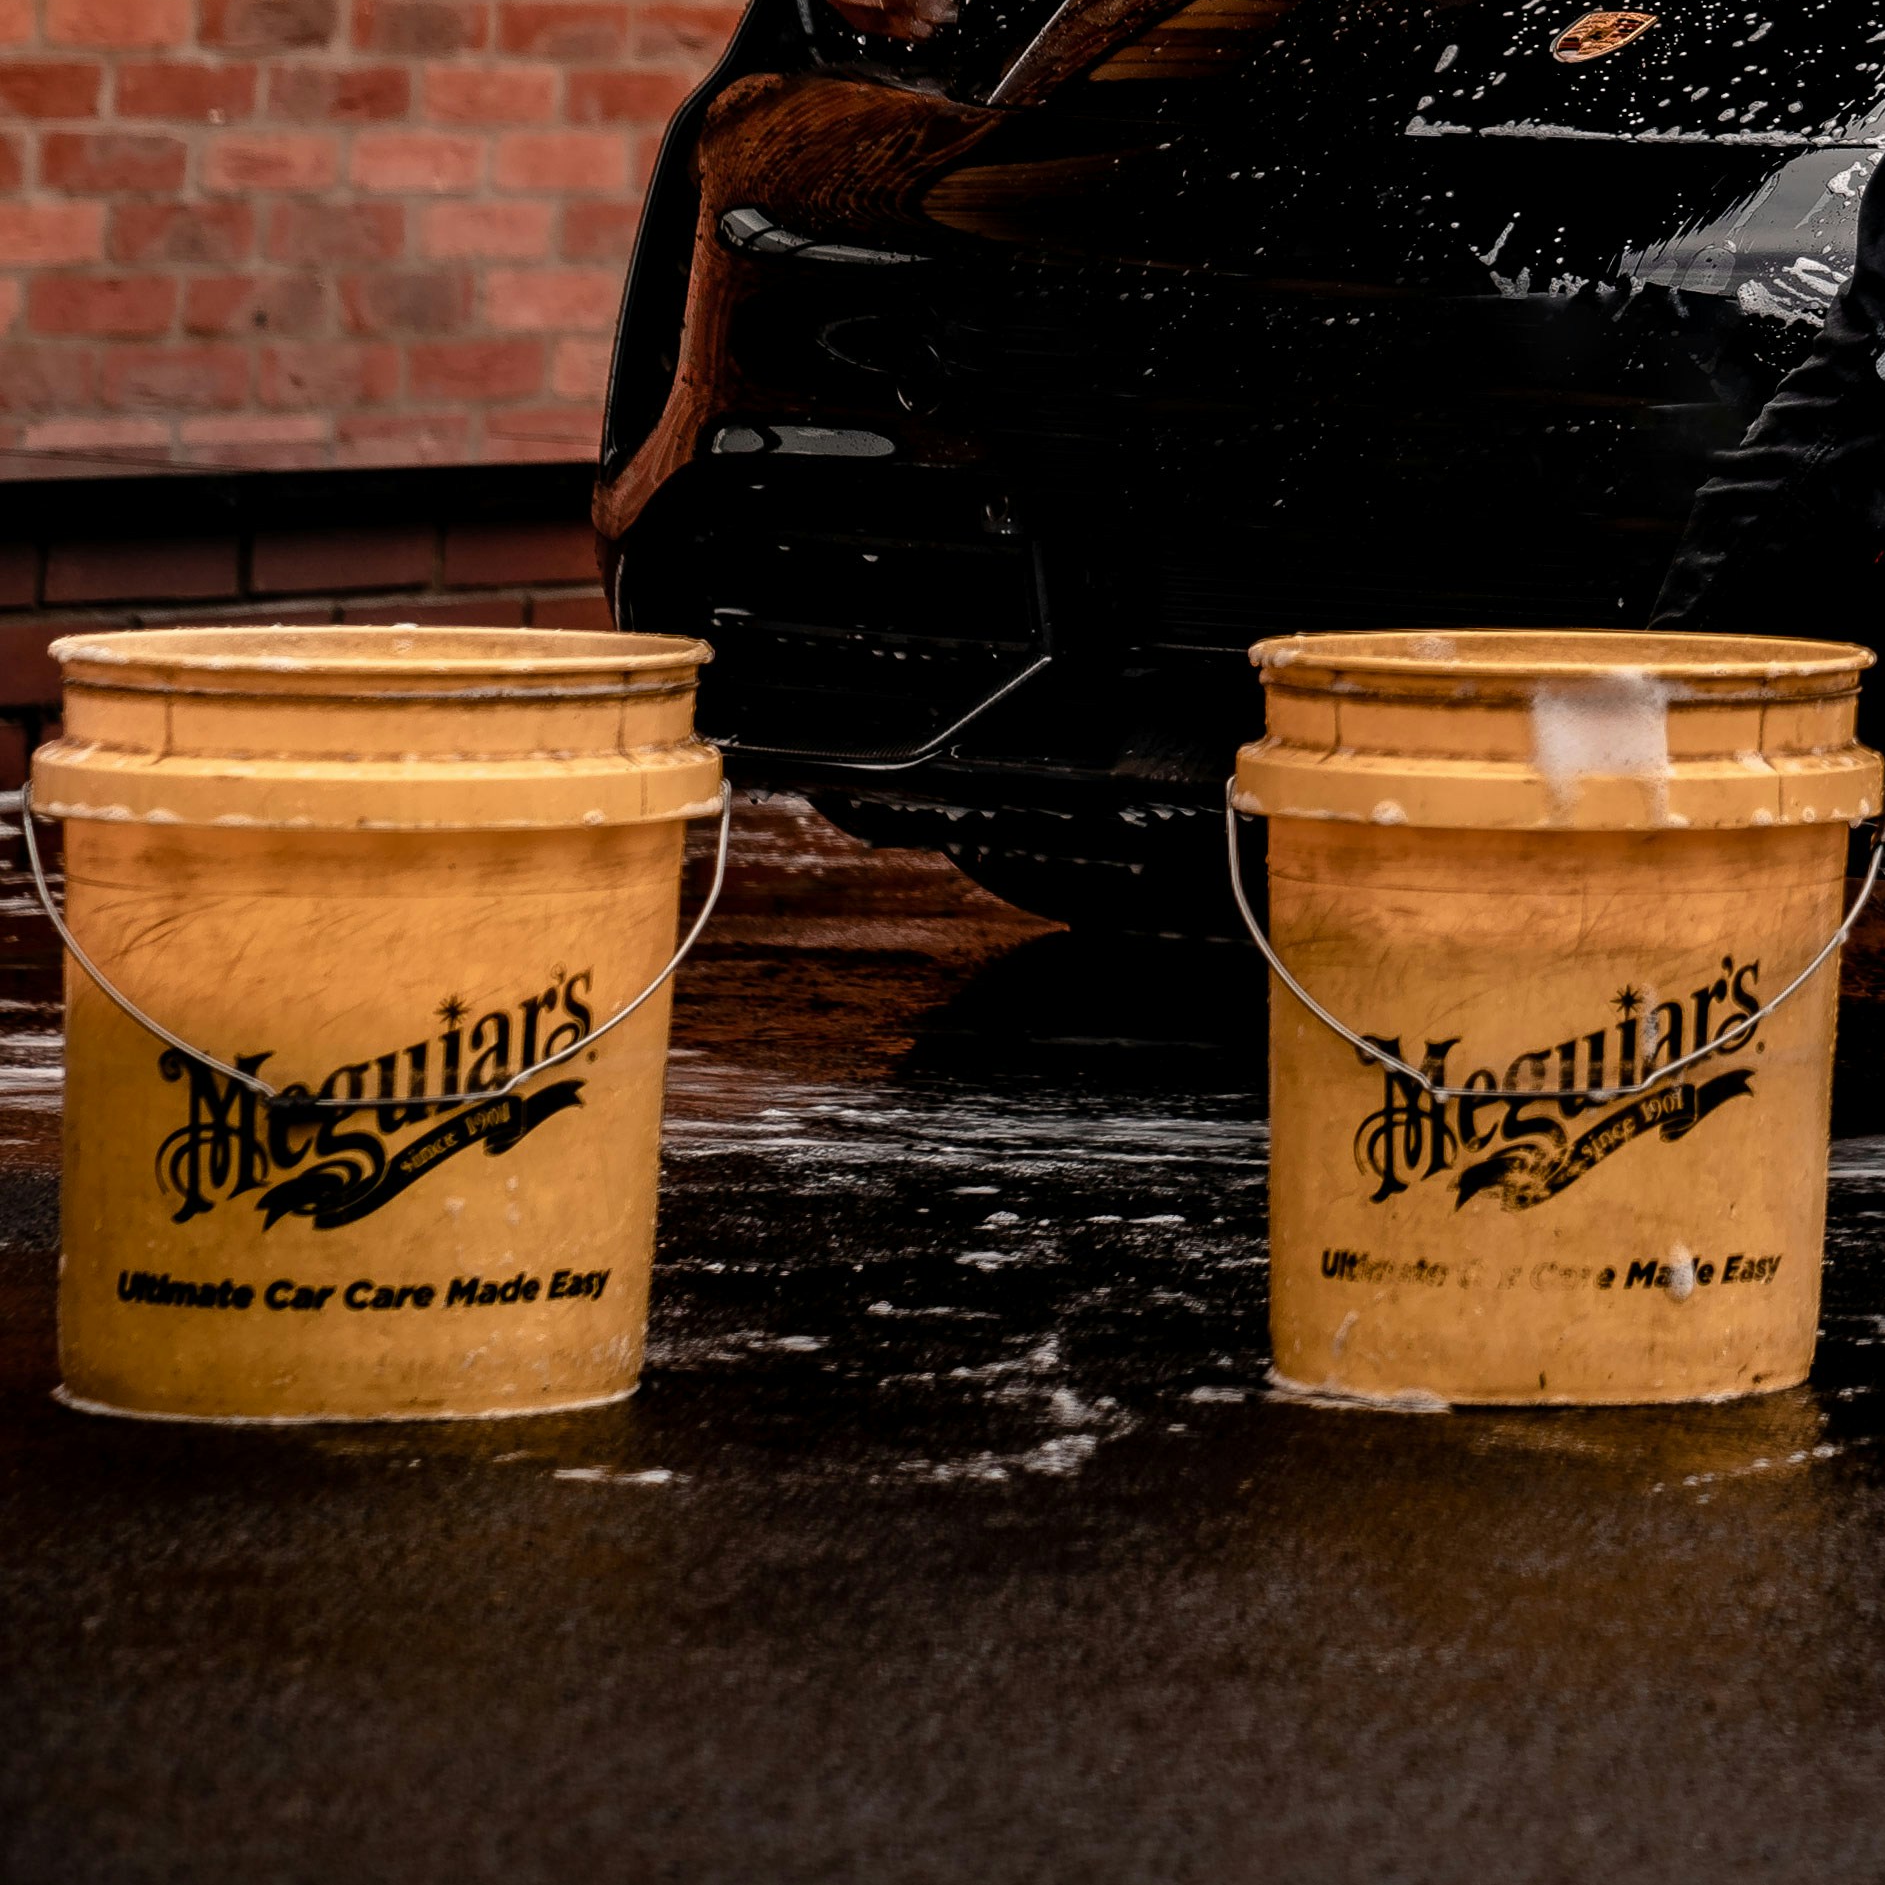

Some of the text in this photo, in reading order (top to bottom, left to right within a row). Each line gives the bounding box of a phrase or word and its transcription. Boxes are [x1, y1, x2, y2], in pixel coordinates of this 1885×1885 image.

[155, 963, 596, 1224] Meguiar's
[1353, 954, 1761, 1205] Meguiar's
[118, 1266, 614, 1311] Ultimate Car Care Made Easy
[1623, 1254, 1716, 1291] Mae
[1720, 1252, 1783, 1286] Easy
